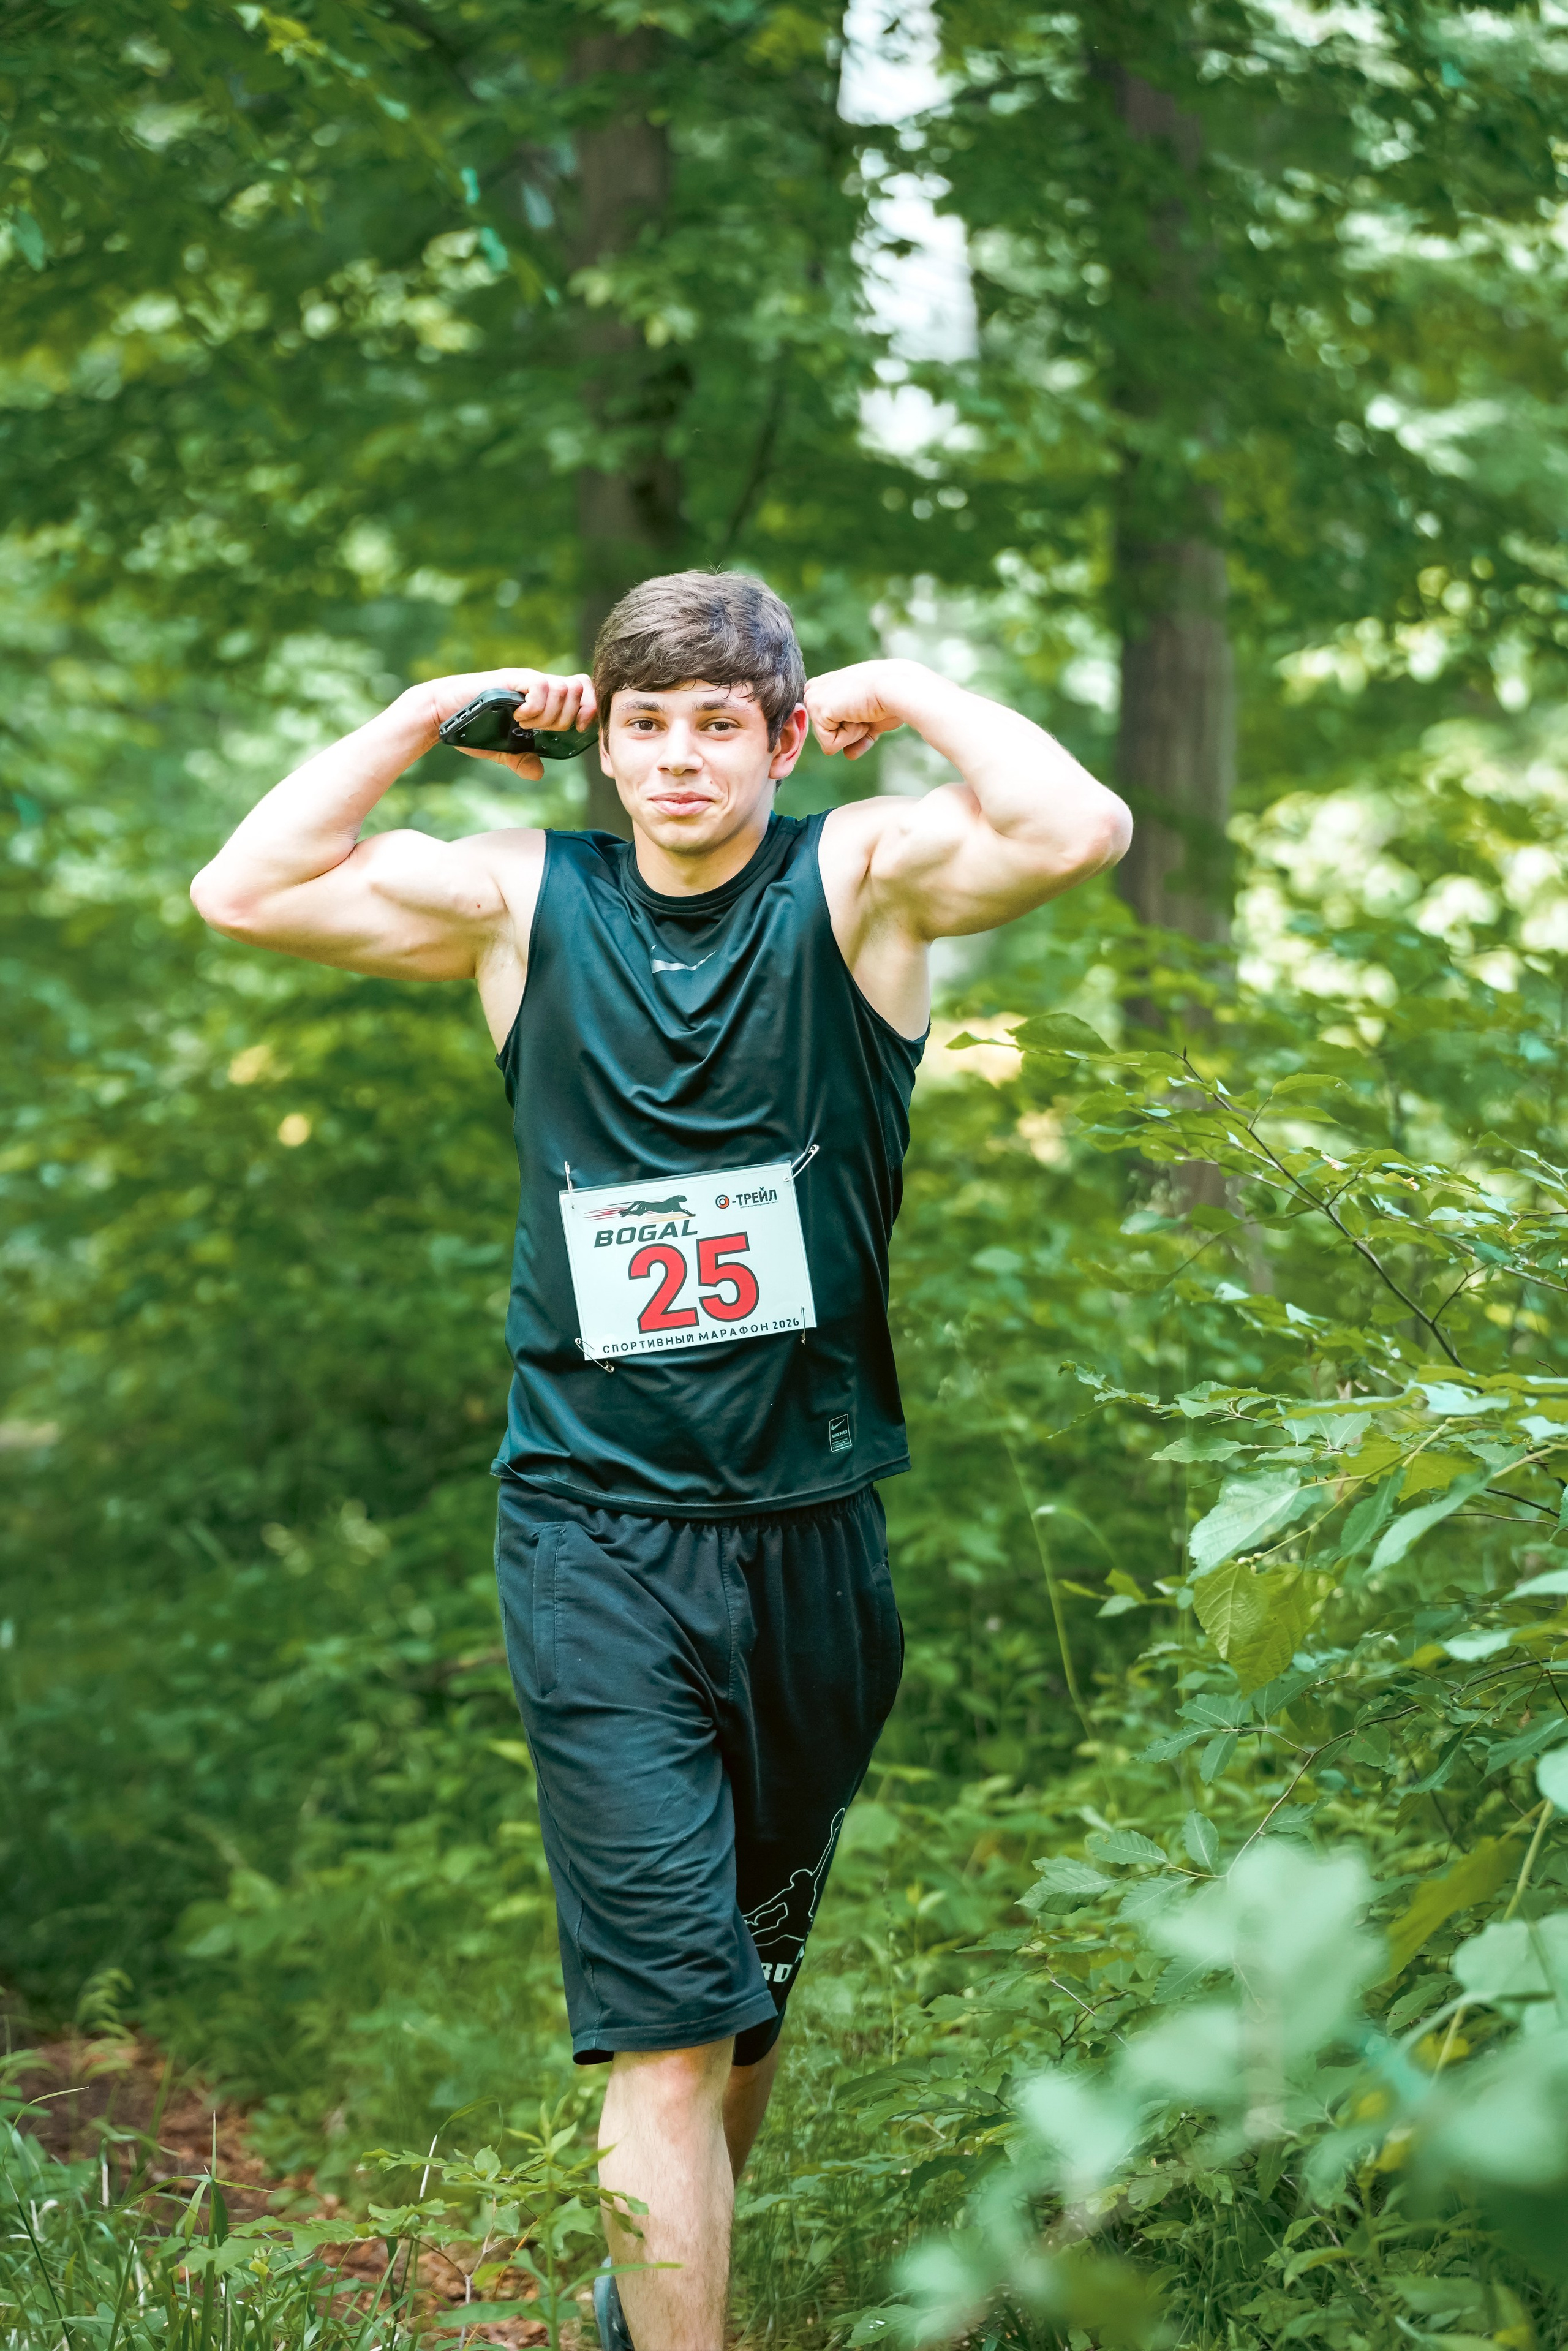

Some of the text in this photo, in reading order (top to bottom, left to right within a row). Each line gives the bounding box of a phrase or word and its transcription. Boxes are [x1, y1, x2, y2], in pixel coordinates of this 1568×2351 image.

[594, 1219, 698, 1248] BOGAL
[628, 1231, 760, 1334] 25
[601, 1318, 800, 1354] СПОРТИВНЫЙ МАРАФОН 2026
[761, 1962, 793, 1983] RD
